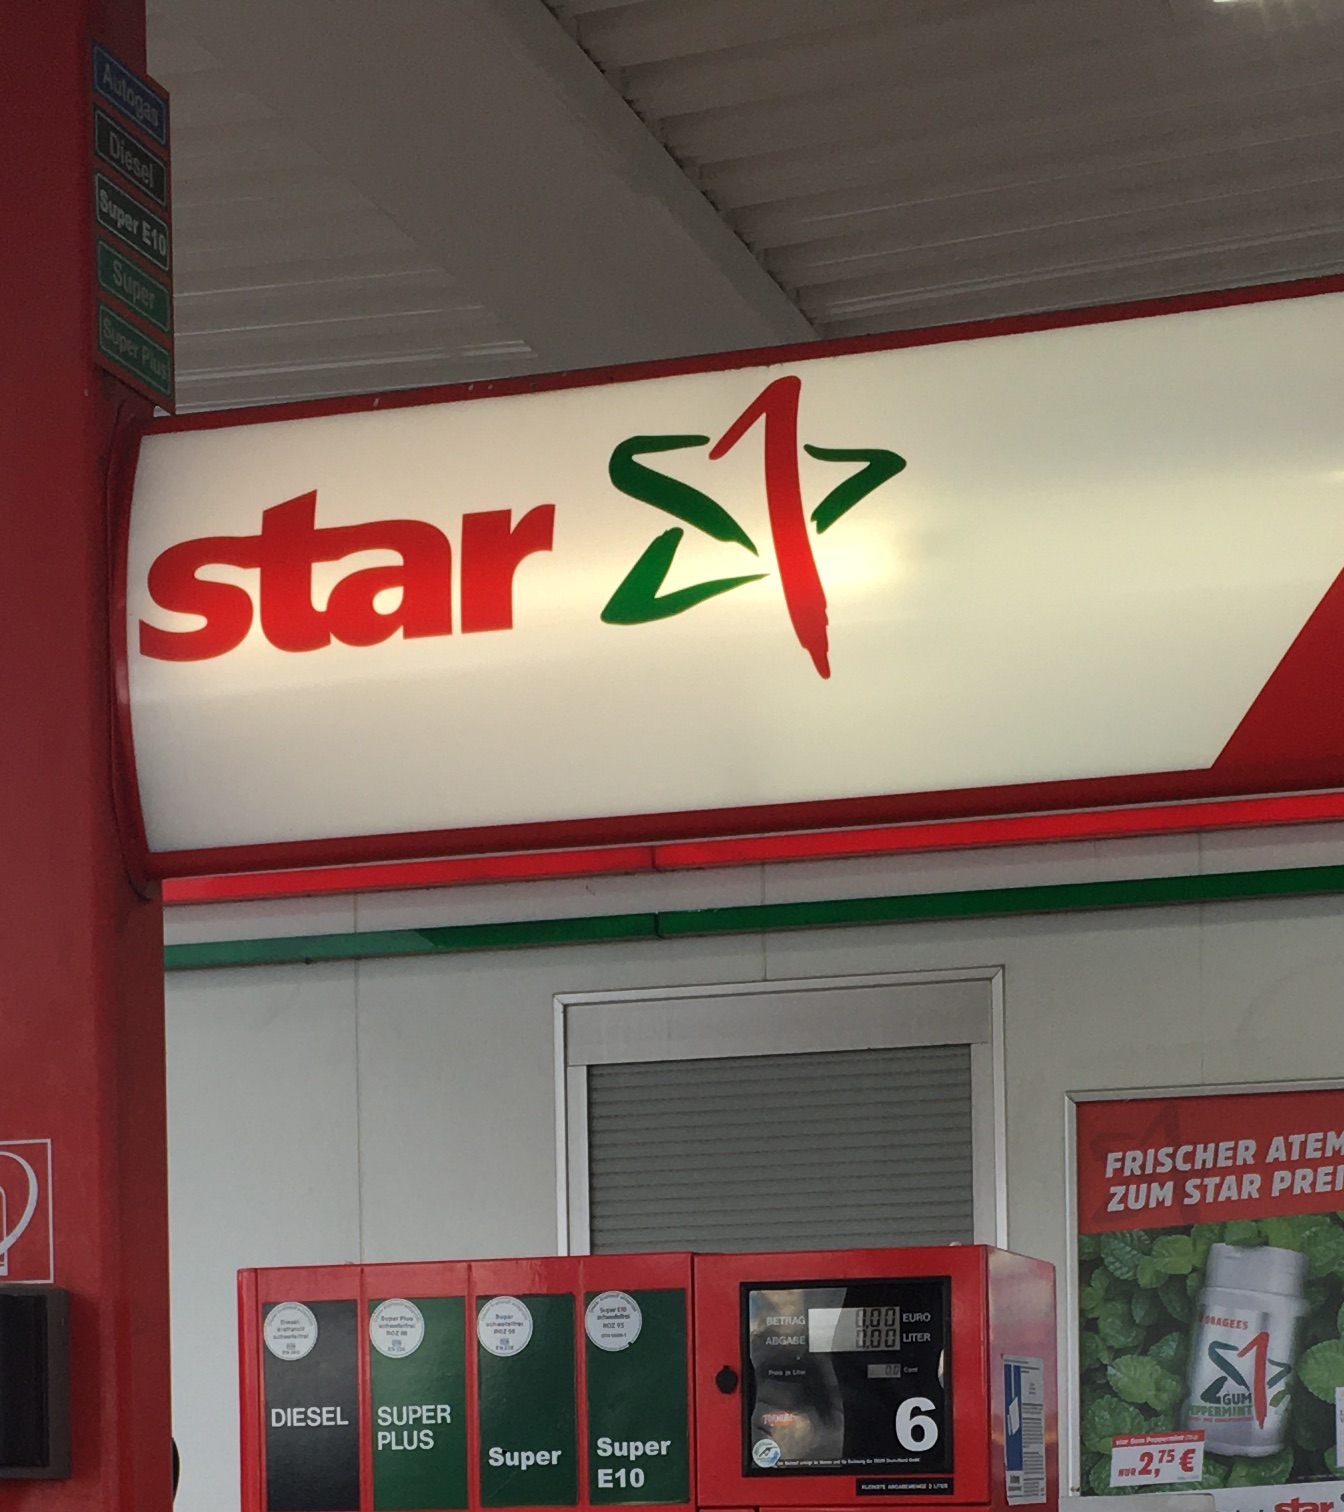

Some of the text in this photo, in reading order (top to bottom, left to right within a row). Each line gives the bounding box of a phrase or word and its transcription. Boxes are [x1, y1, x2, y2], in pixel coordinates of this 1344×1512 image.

[102, 62, 159, 127] Autogas
[108, 130, 153, 188] Diesel
[99, 188, 167, 257] Super E10
[112, 259, 155, 309] Super
[102, 316, 168, 381] Super Plus
[138, 488, 558, 663] star
[1104, 1137, 1257, 1179] FRISCHER
[1107, 1184, 1173, 1213] ZUM
[1183, 1173, 1262, 1205] STAR
[766, 1312, 931, 1326] BETRAG EURO
[765, 1332, 931, 1345] ABGABE LITER
[1188, 1405, 1253, 1417] EPPERMINT
[1222, 1392, 1252, 1406] GUM
[270, 1407, 350, 1428] DIESEL
[377, 1404, 452, 1427] SUPER
[895, 1396, 939, 1452] 6
[377, 1430, 435, 1451] PLUS
[596, 1436, 672, 1461] Super
[488, 1446, 563, 1471] Super
[1179, 1448, 1196, 1472] €
[597, 1467, 646, 1490] E10
